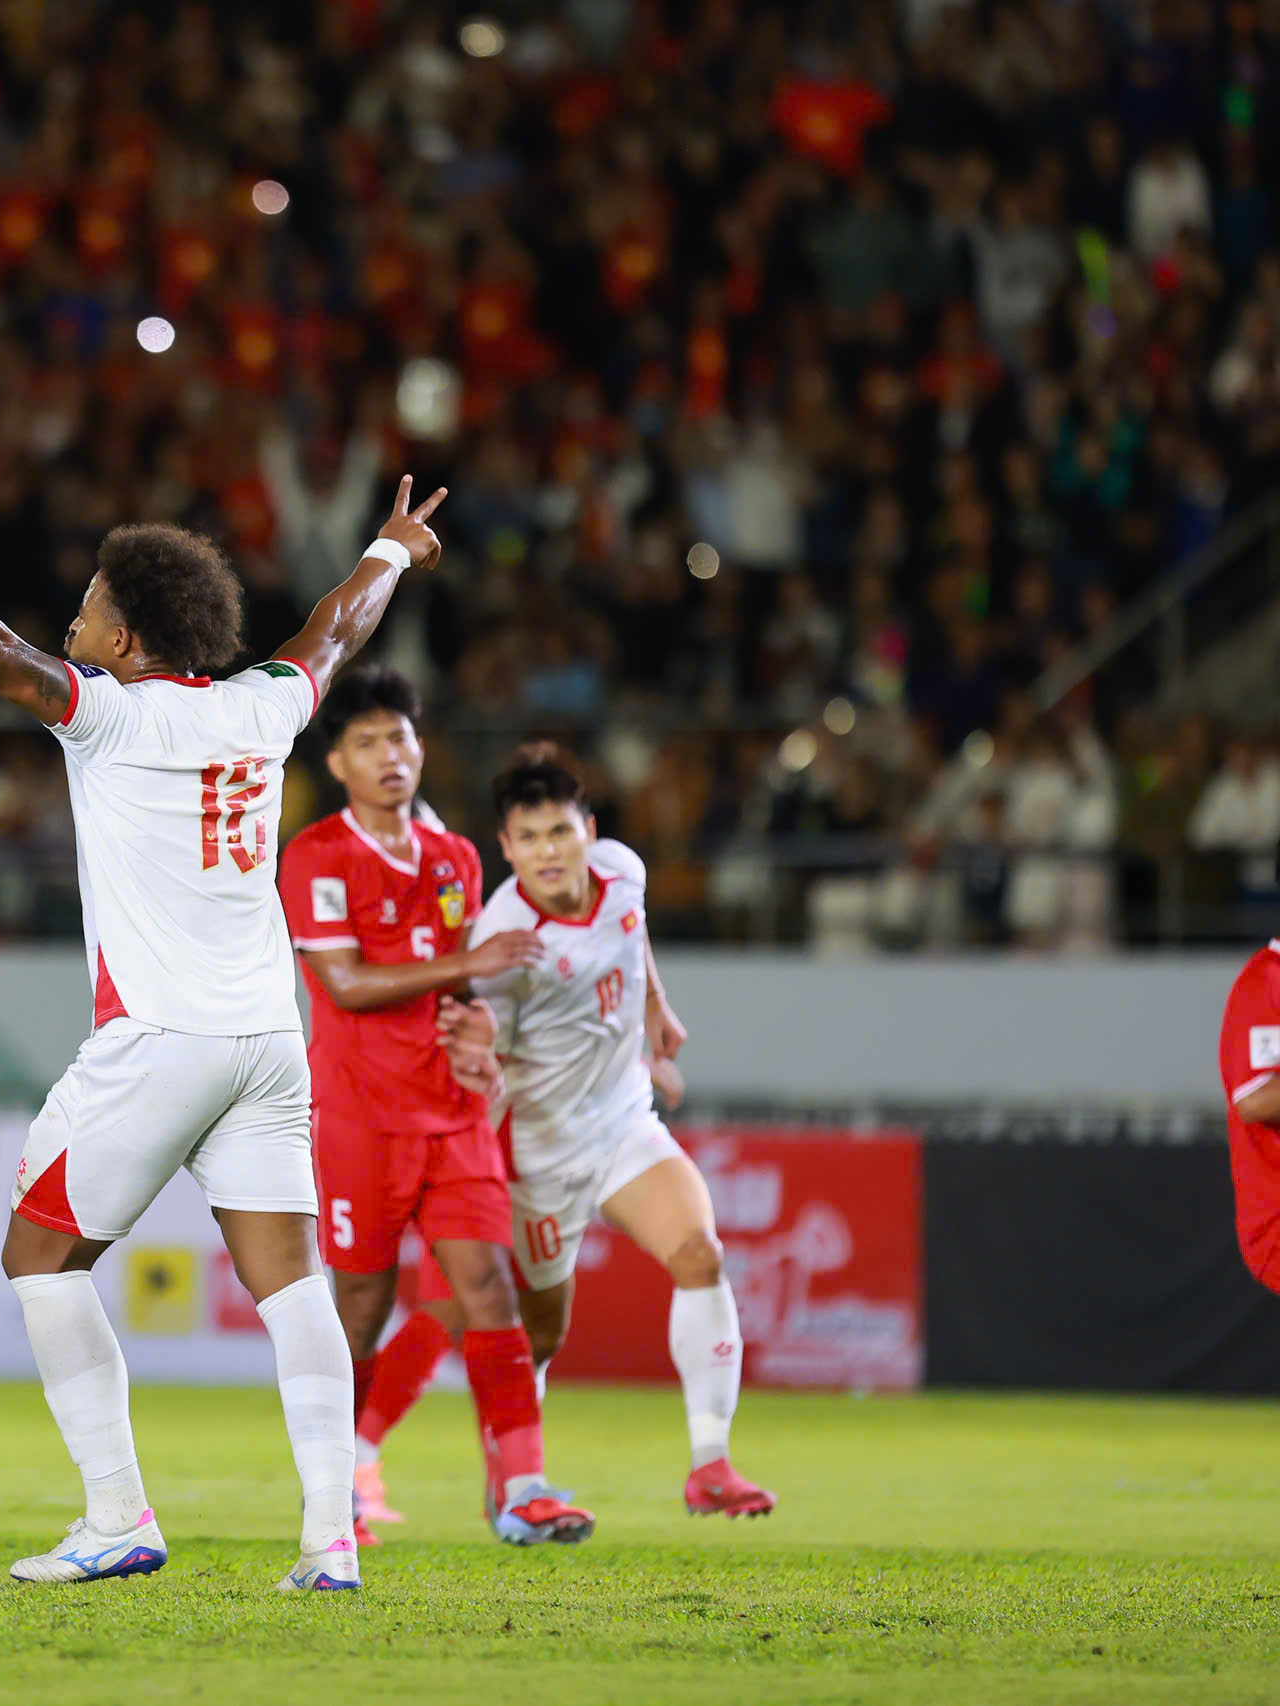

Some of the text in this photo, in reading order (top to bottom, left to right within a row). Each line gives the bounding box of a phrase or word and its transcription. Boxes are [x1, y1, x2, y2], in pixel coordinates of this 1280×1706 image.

[411, 926, 435, 961] 5
[596, 968, 625, 1020] 10
[331, 1200, 355, 1249] 5
[525, 1215, 563, 1264] 10
